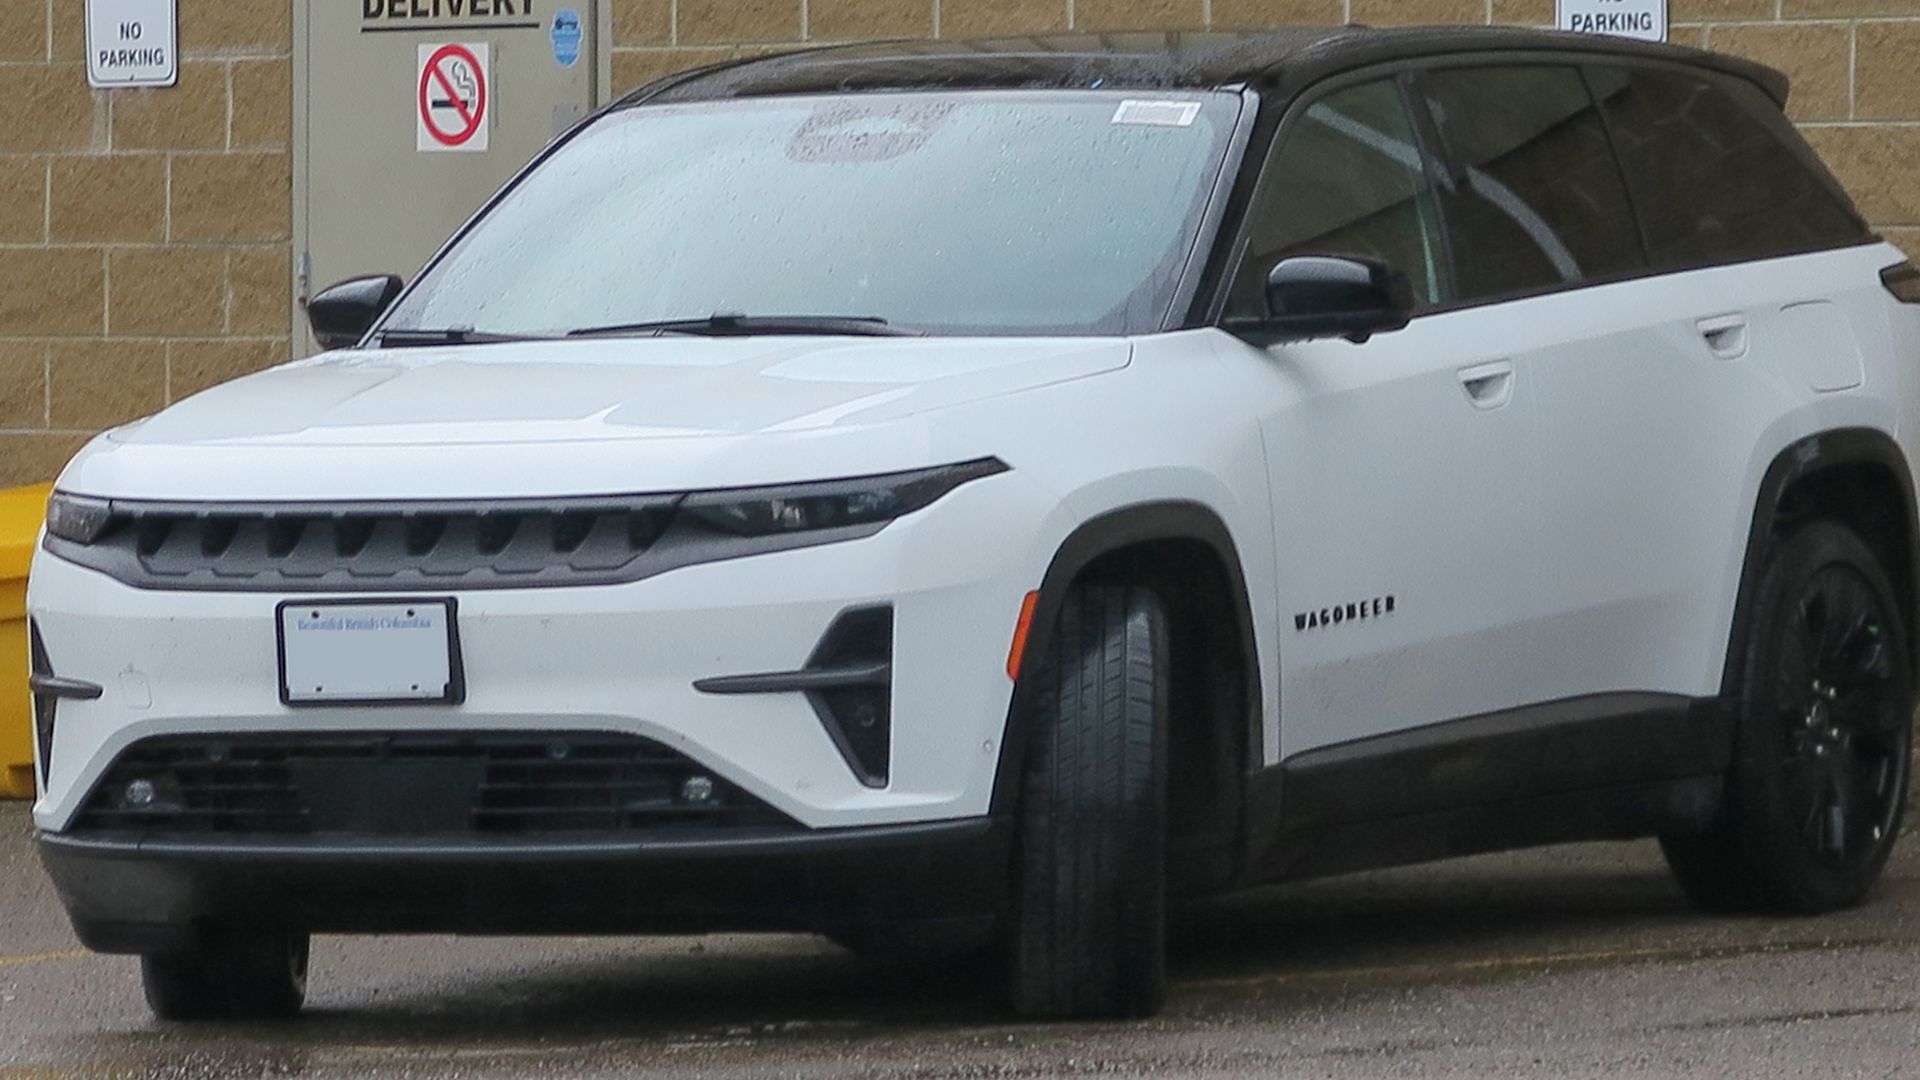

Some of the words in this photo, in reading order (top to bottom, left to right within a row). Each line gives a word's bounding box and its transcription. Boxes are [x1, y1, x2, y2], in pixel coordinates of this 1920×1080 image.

[119, 22, 142, 40] NO
[1571, 12, 1652, 32] PARKING
[99, 48, 164, 67] PARKING
[1295, 596, 1395, 630] WAGONEER
